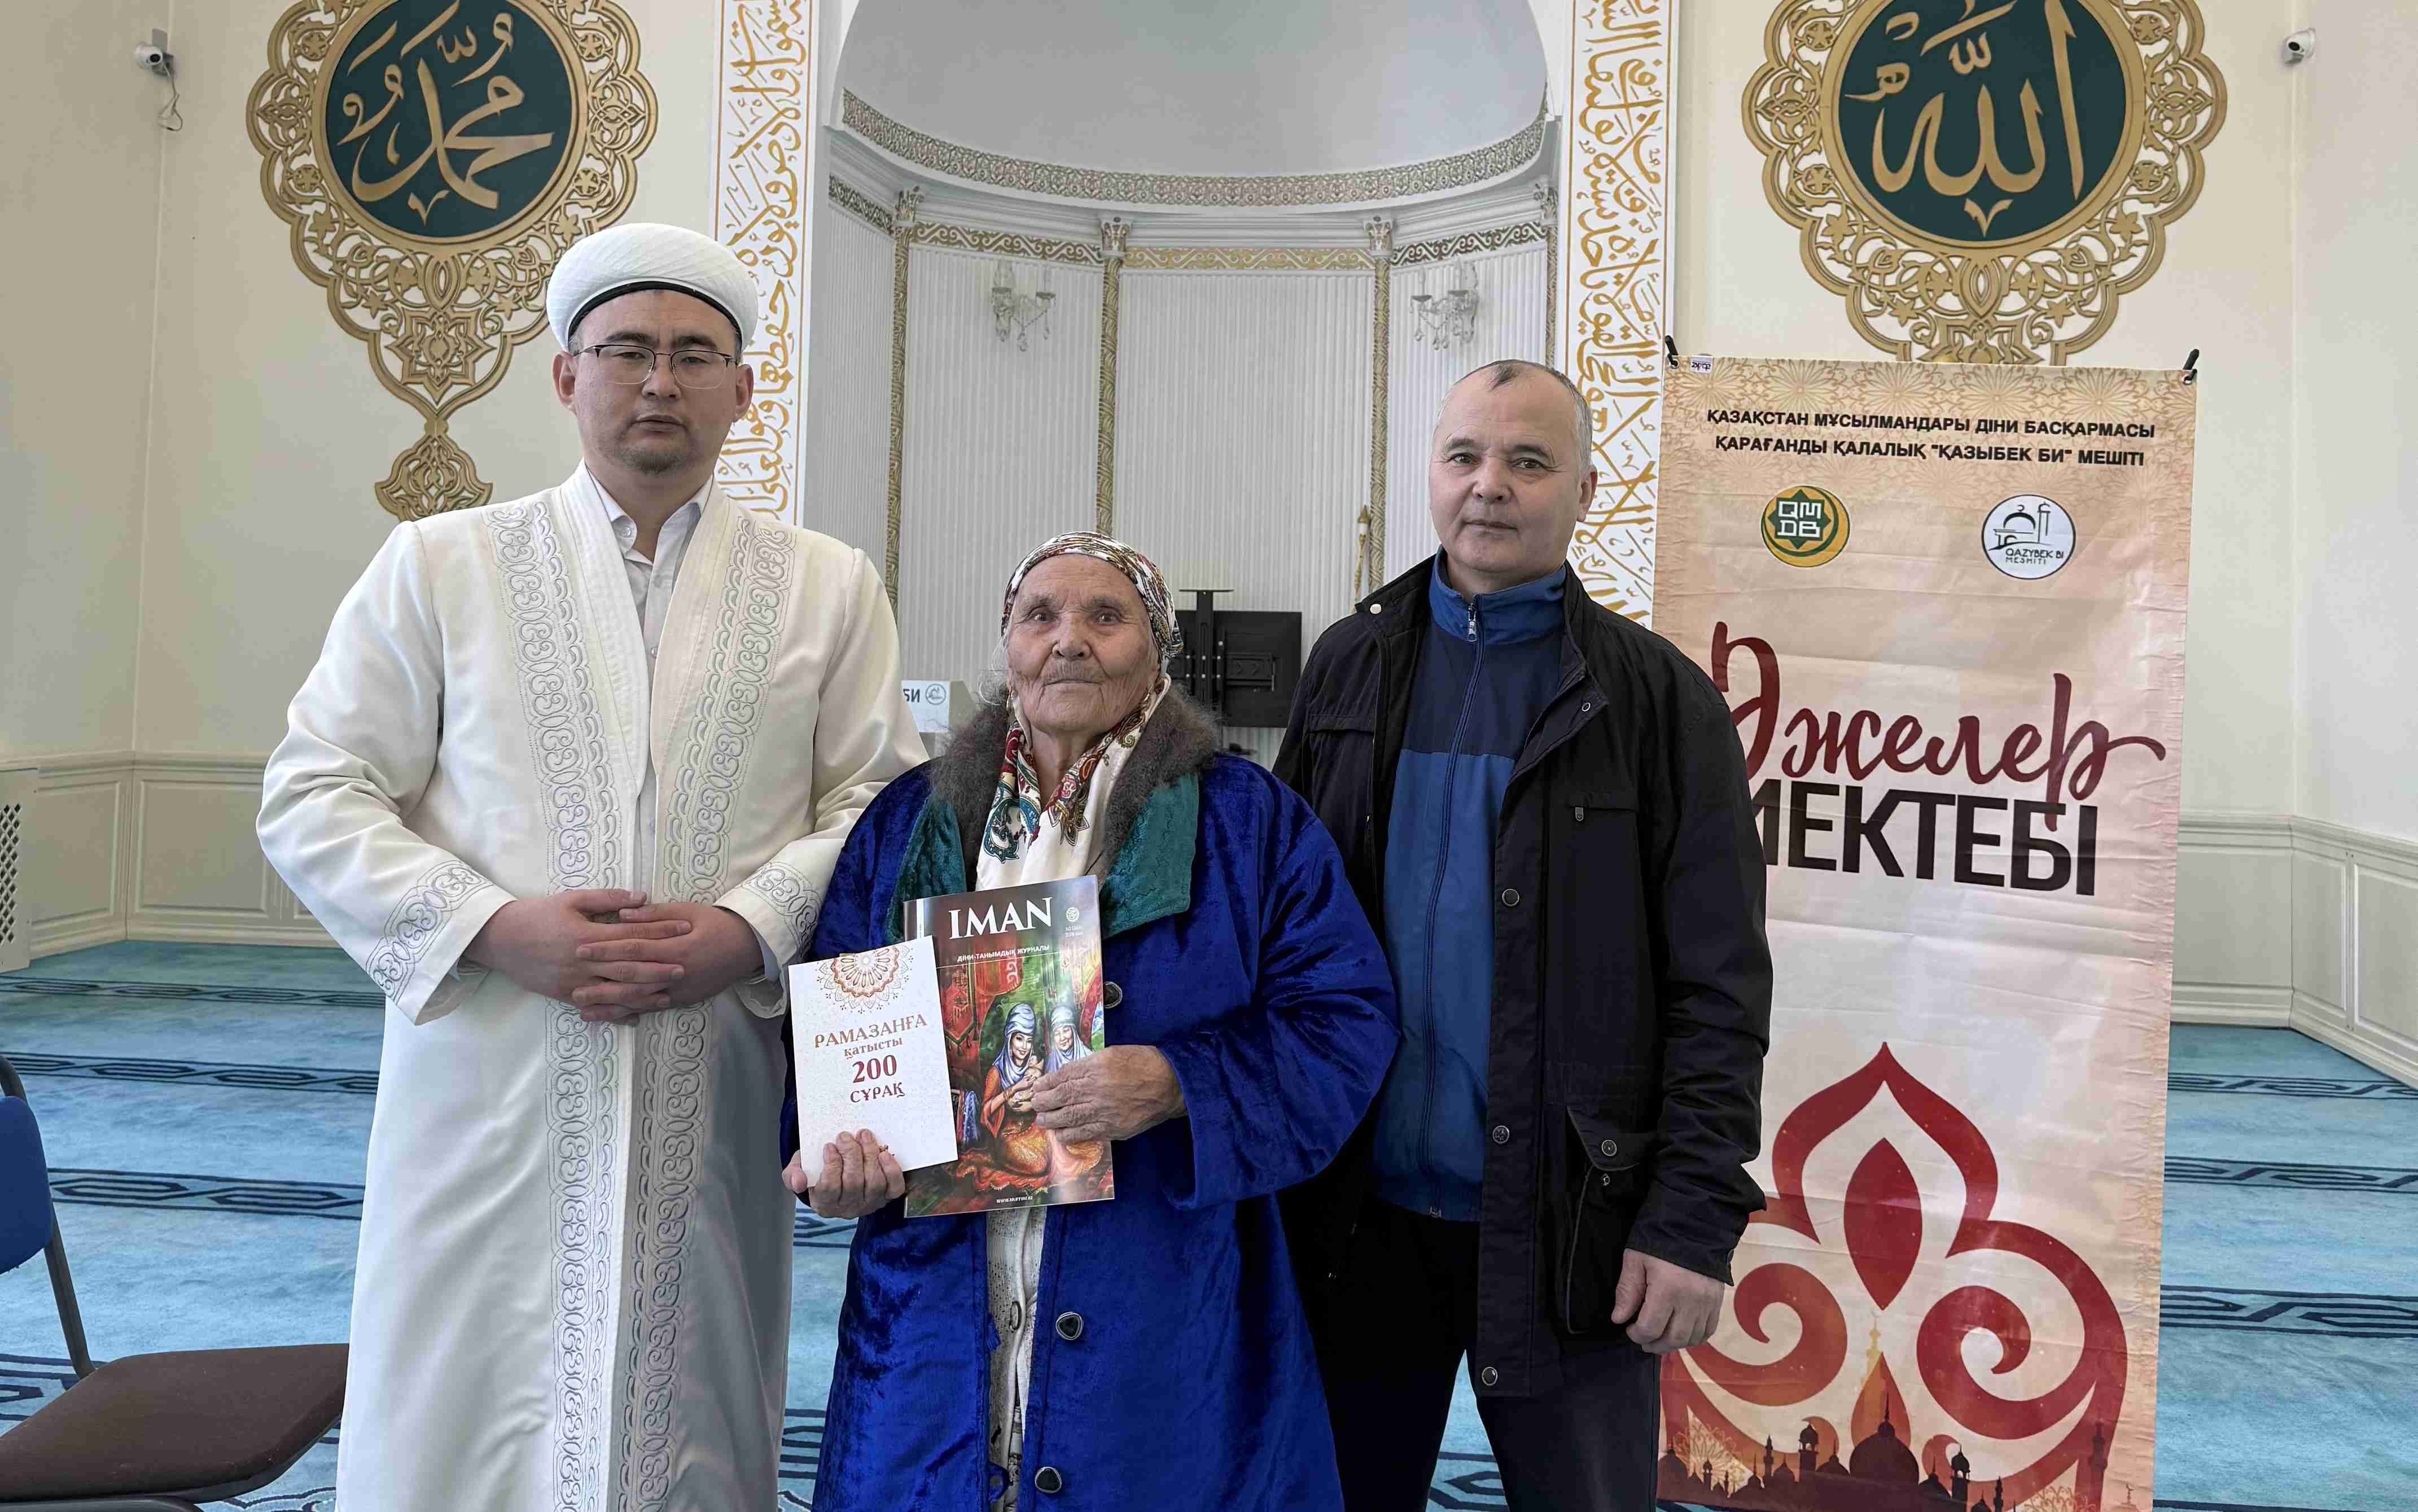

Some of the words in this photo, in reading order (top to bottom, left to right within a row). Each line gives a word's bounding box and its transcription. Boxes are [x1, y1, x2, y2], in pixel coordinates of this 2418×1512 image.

[1707, 409, 1808, 426] ҚАЗАҚСТАН
[1814, 413, 1970, 432] МҰСЫЛМАНДАРЫ
[1976, 419, 2018, 433] ДІНИ
[2025, 420, 2155, 438] БАСҚАРМАСЫ
[1715, 436, 1827, 455] ҚАРАҒАНДЫ
[1833, 440, 1926, 459] ҚАЛАЛЫҚ
[1931, 444, 2032, 461] "ҚАЗЫБЕК
[2038, 448, 2073, 463] БИ"
[2078, 450, 2144, 466] МЕШІТІ
[2005, 548, 2053, 558] QAZYBEK
[2056, 550, 2064, 559] BI
[948, 897, 1052, 940] IMAN
[1017, 944, 1049, 954] ЖУРНАЛЫ
[814, 1014, 927, 1048] РАМАЗАНҒА
[844, 1037, 903, 1059] қатысты
[852, 1054, 897, 1083] 200
[850, 1081, 905, 1103] СҰРАҚ
